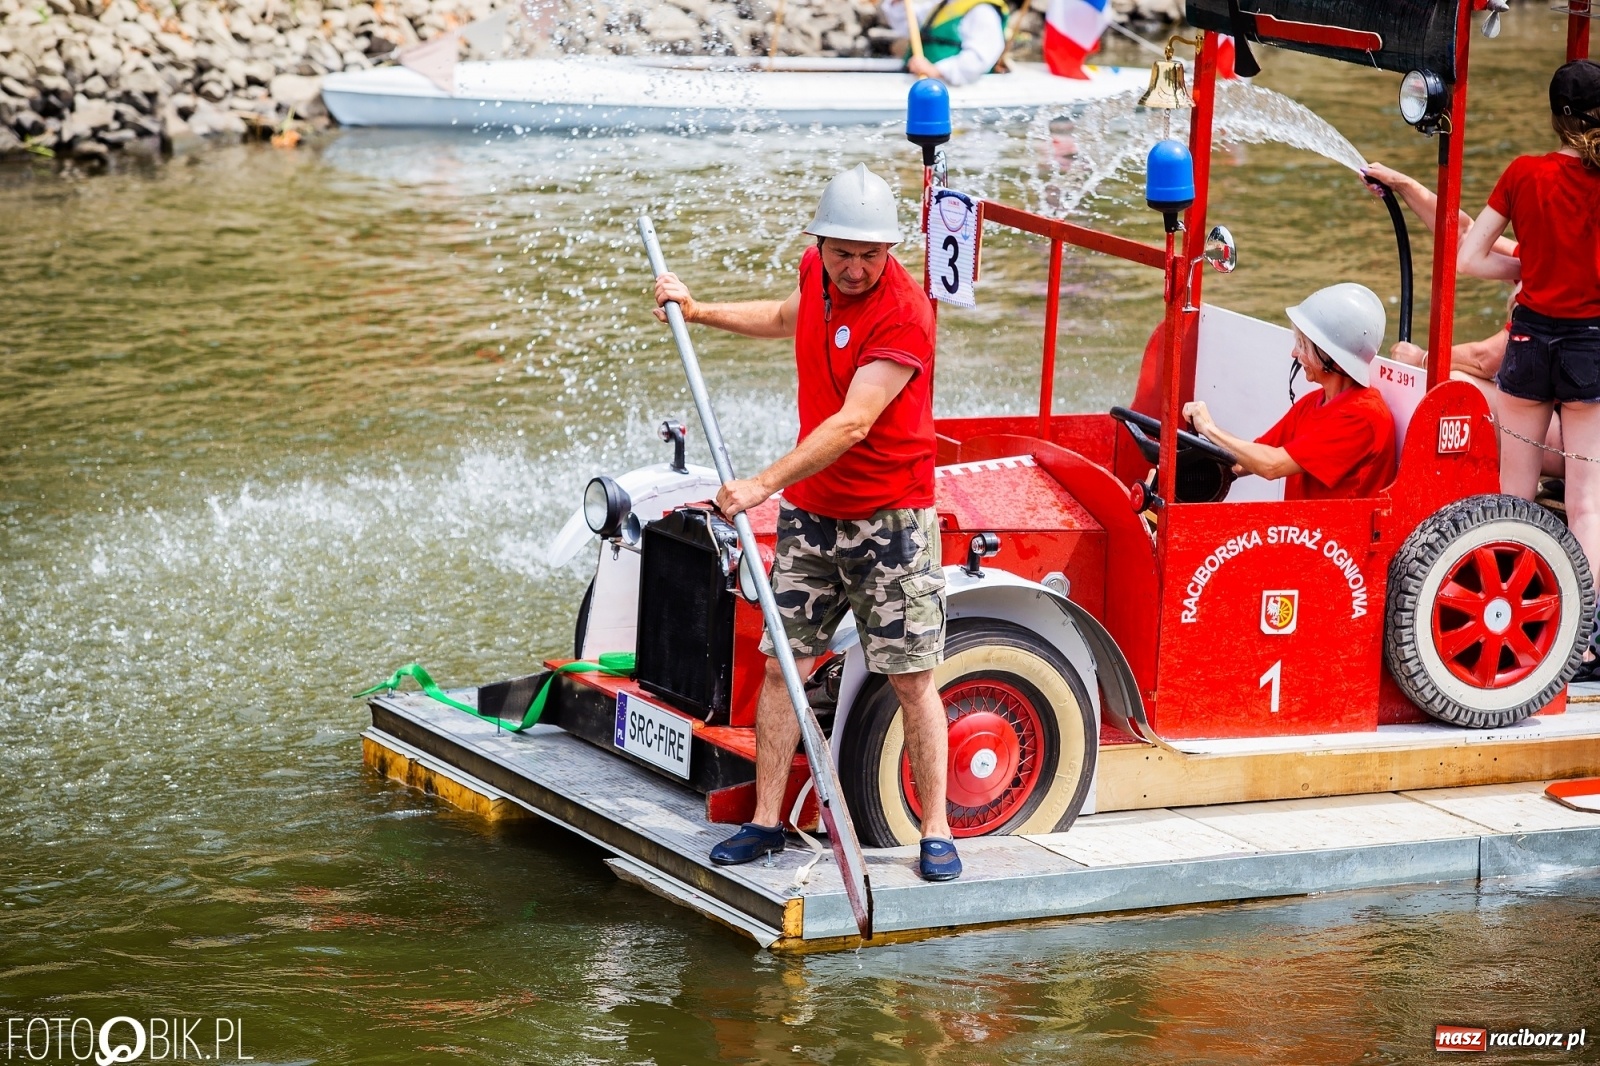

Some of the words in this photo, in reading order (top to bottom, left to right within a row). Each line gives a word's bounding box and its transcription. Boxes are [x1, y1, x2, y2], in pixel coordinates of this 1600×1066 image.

[941, 235, 959, 294] 3
[1380, 365, 1393, 381] PZ
[1397, 371, 1415, 387] 391
[1441, 420, 1461, 450] 998
[1181, 530, 1263, 624] RACIBORSKA
[1267, 525, 1323, 551] STRAŻ
[1323, 540, 1368, 620] OGNIOWA
[1259, 659, 1282, 713] 1
[617, 728, 624, 740] PL
[629, 710, 685, 763] SRC-FIRE
